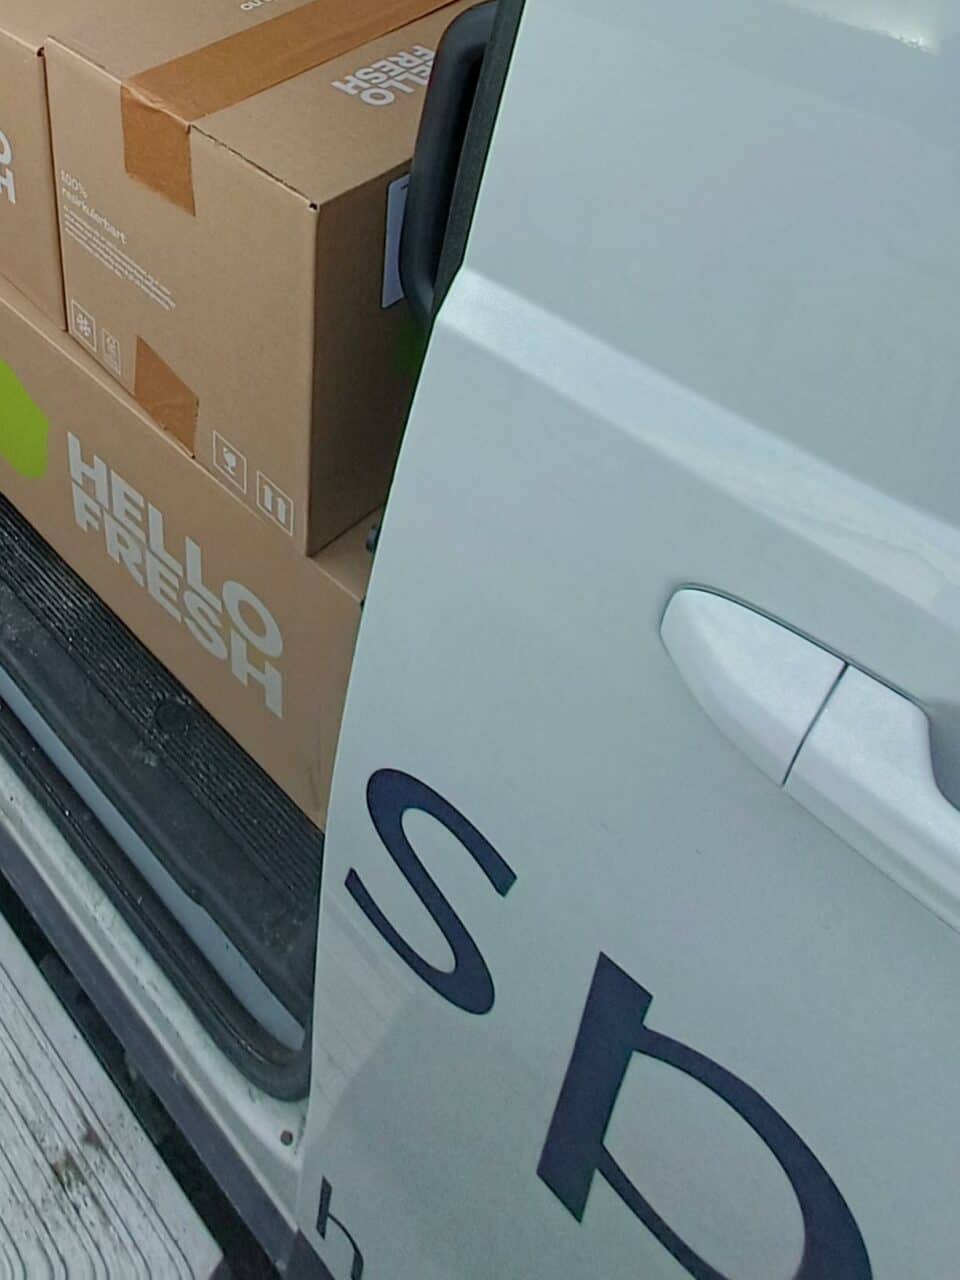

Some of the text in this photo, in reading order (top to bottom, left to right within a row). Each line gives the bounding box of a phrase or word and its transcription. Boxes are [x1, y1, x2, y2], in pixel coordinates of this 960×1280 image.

[360, 60, 434, 106] ELLO
[67, 431, 284, 658] HELLO
[72, 481, 283, 718] FRESH
